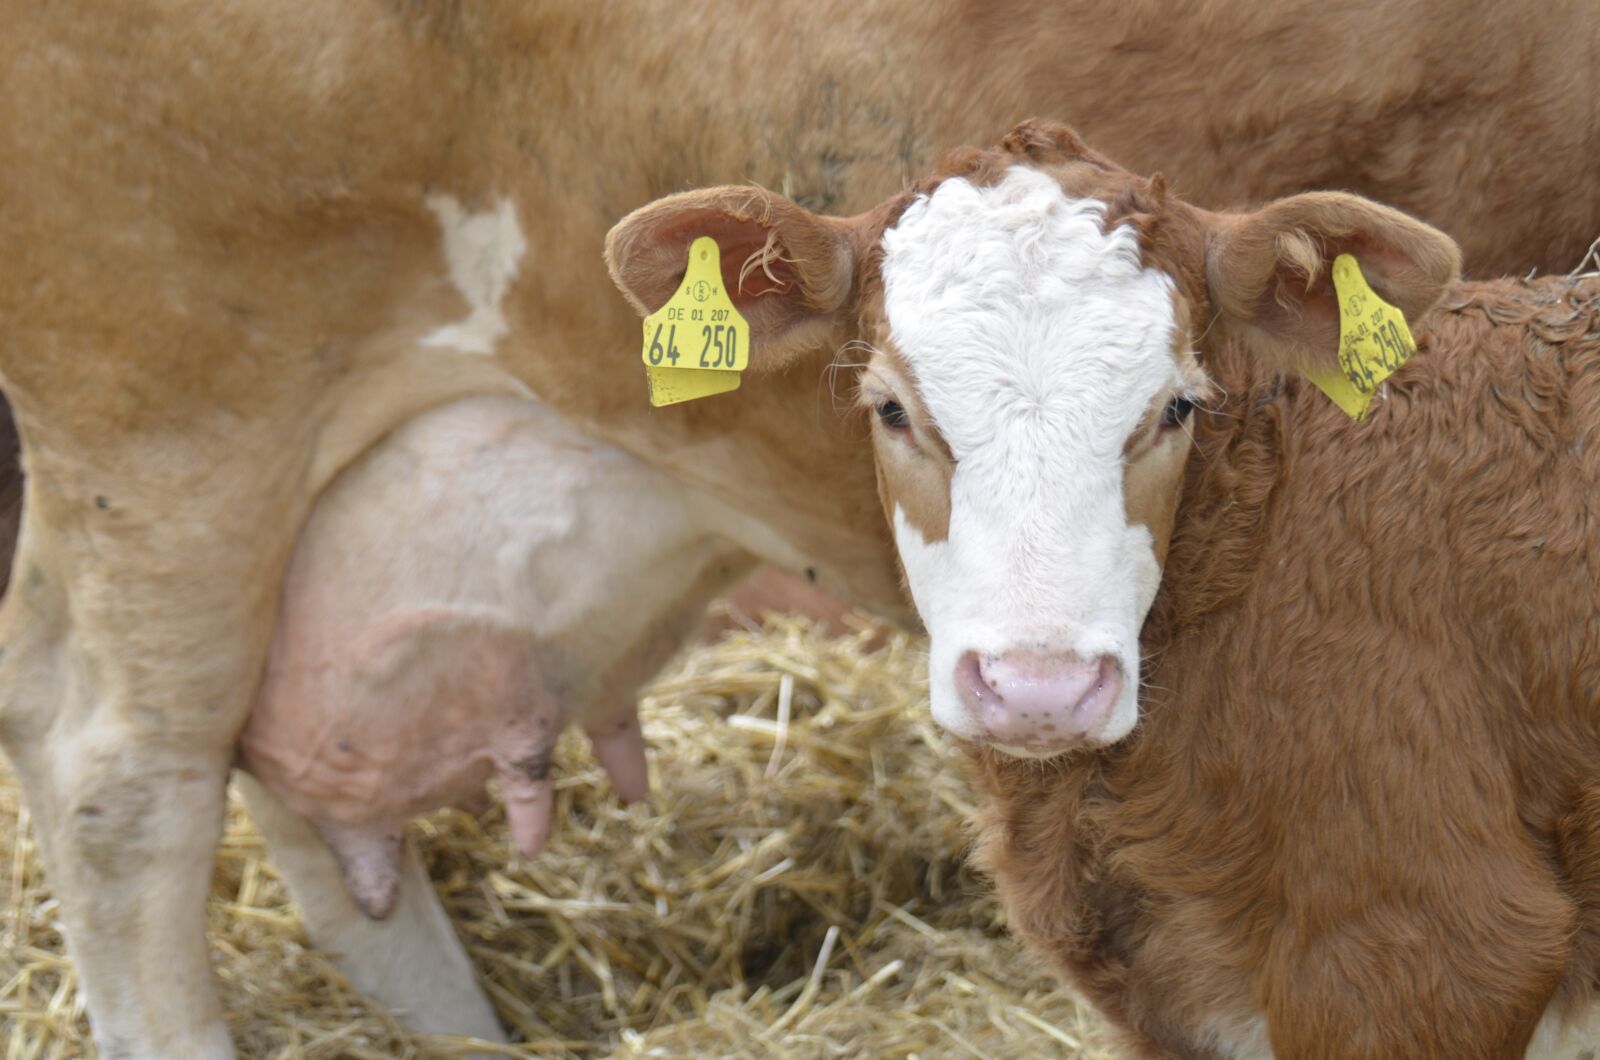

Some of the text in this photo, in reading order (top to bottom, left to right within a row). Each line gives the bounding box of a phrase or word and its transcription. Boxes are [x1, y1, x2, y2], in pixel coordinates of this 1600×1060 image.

[667, 307, 730, 322] DE 01 207
[1369, 308, 1384, 326] 207
[648, 323, 737, 369] 64 250
[1345, 319, 1407, 394] 64 250
